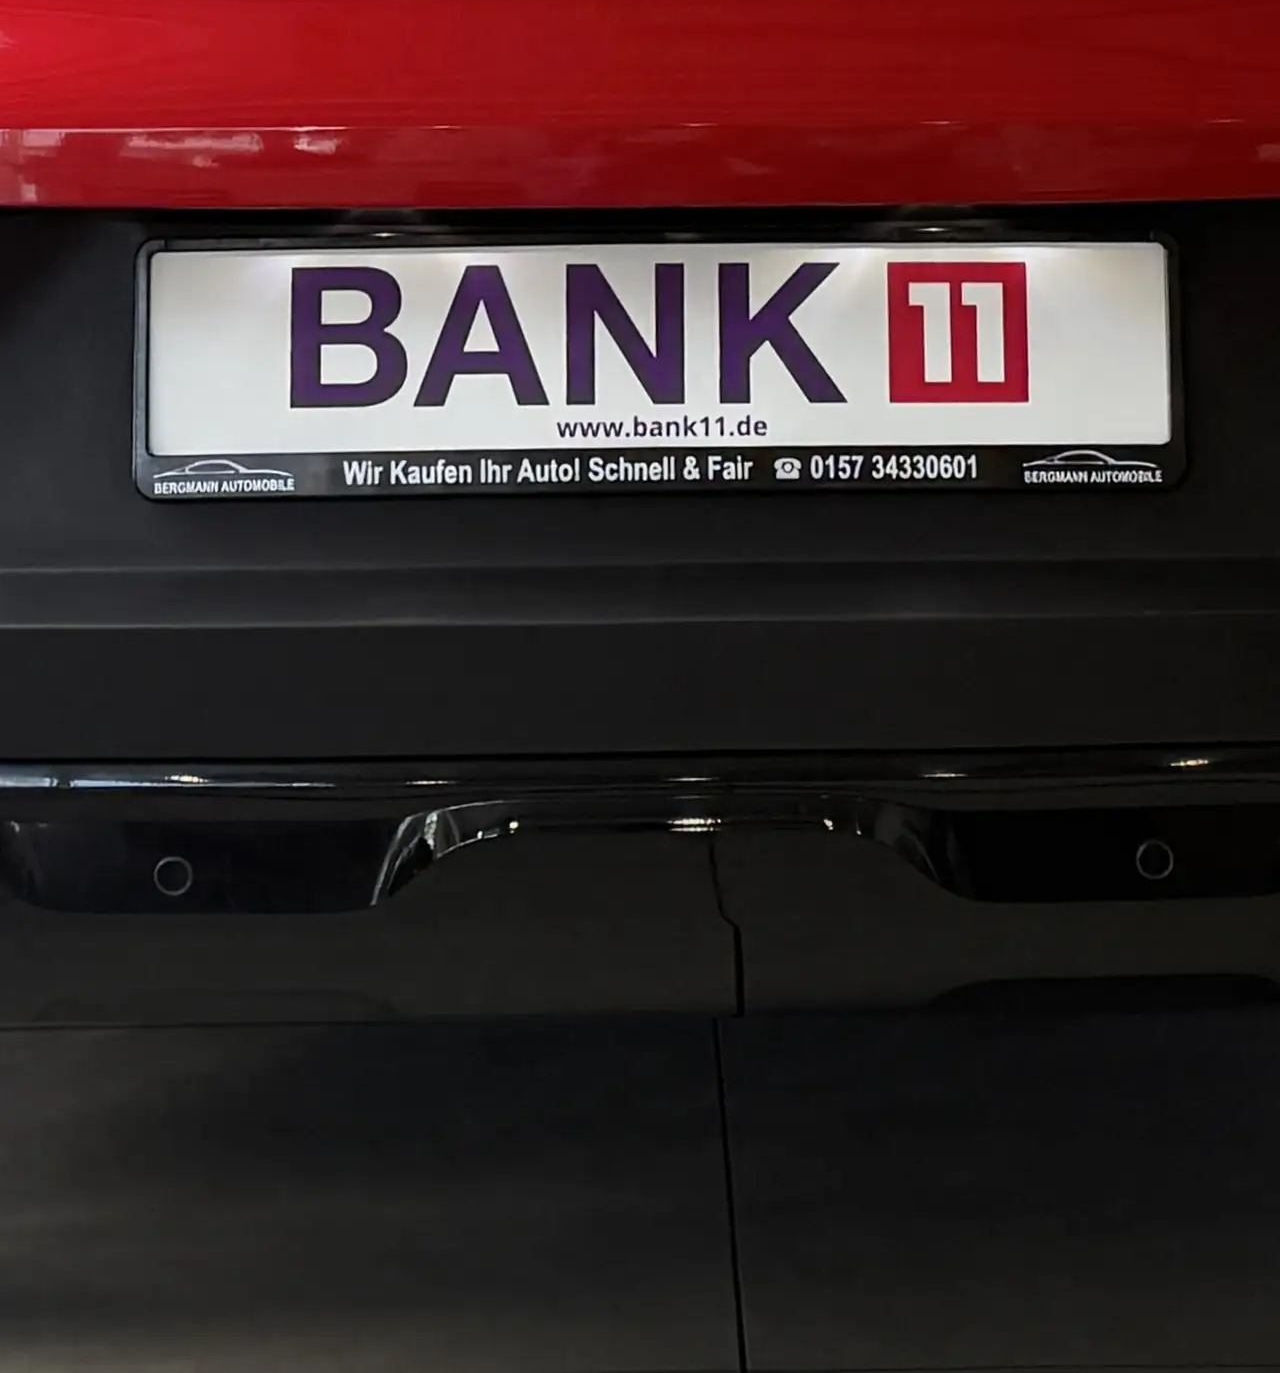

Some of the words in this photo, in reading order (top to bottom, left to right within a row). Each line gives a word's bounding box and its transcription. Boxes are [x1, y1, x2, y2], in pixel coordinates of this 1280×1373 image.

[290, 262, 847, 408] BANK
[908, 281, 1006, 384] 11
[557, 415, 768, 438] www.bank11.de
[342, 460, 384, 486] Wir
[390, 458, 473, 485] Kaufen
[479, 458, 512, 483] Ihr
[516, 457, 581, 483] Auto!
[588, 455, 676, 482] Schnell
[683, 455, 701, 481] &
[707, 455, 754, 481] Fair
[810, 454, 864, 479] 0157
[871, 454, 978, 479] 34330601
[1024, 470, 1087, 484] BERGMANN
[1090, 470, 1163, 484] AUTOMOBILE
[154, 481, 219, 494] BERGMANN
[221, 478, 295, 492] AUTOMOBILE
